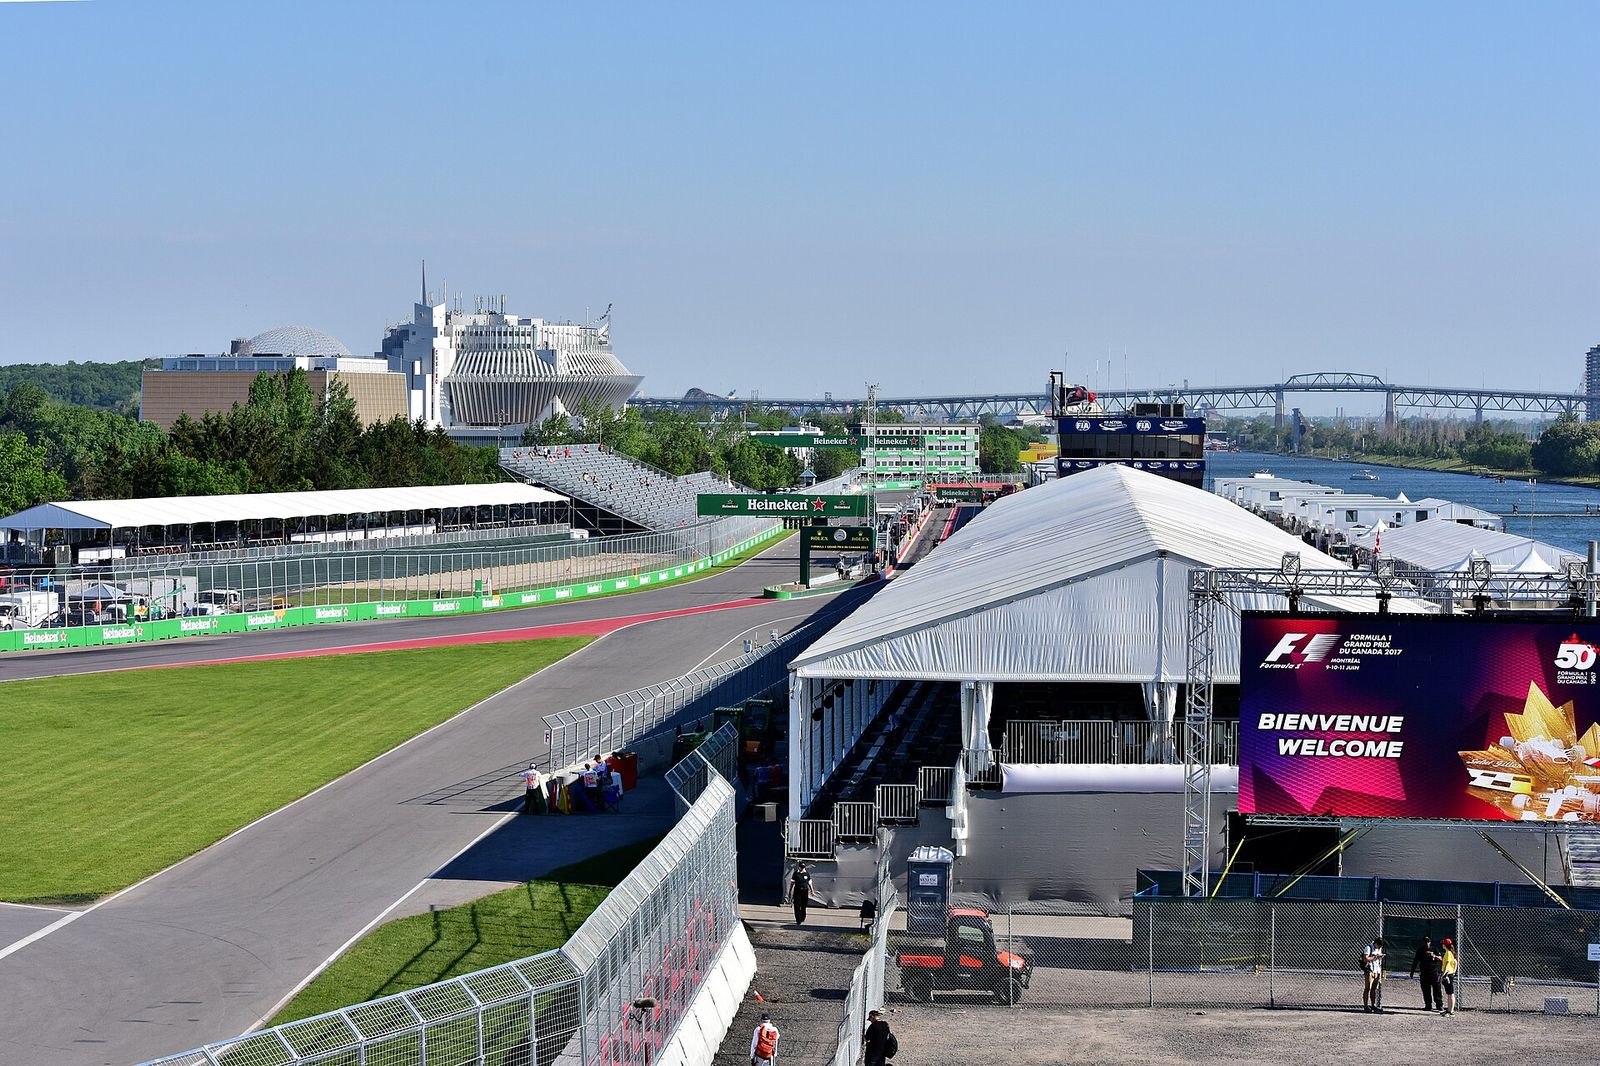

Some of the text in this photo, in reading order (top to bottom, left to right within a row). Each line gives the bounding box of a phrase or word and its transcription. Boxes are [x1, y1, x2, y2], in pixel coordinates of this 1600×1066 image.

[813, 437, 848, 445] Heineken
[874, 437, 908, 445] Heineken
[747, 498, 808, 510] Heineken
[180, 619, 212, 632] Heineken
[248, 614, 276, 626] Heineken
[24, 632, 59, 644] Heineken
[103, 626, 136, 640] Heineken
[1554, 644, 1597, 670] 50
[1258, 713, 1404, 733] BIENVENUE
[546, 734, 549, 742] F
[1278, 738, 1404, 758] WELCOME
